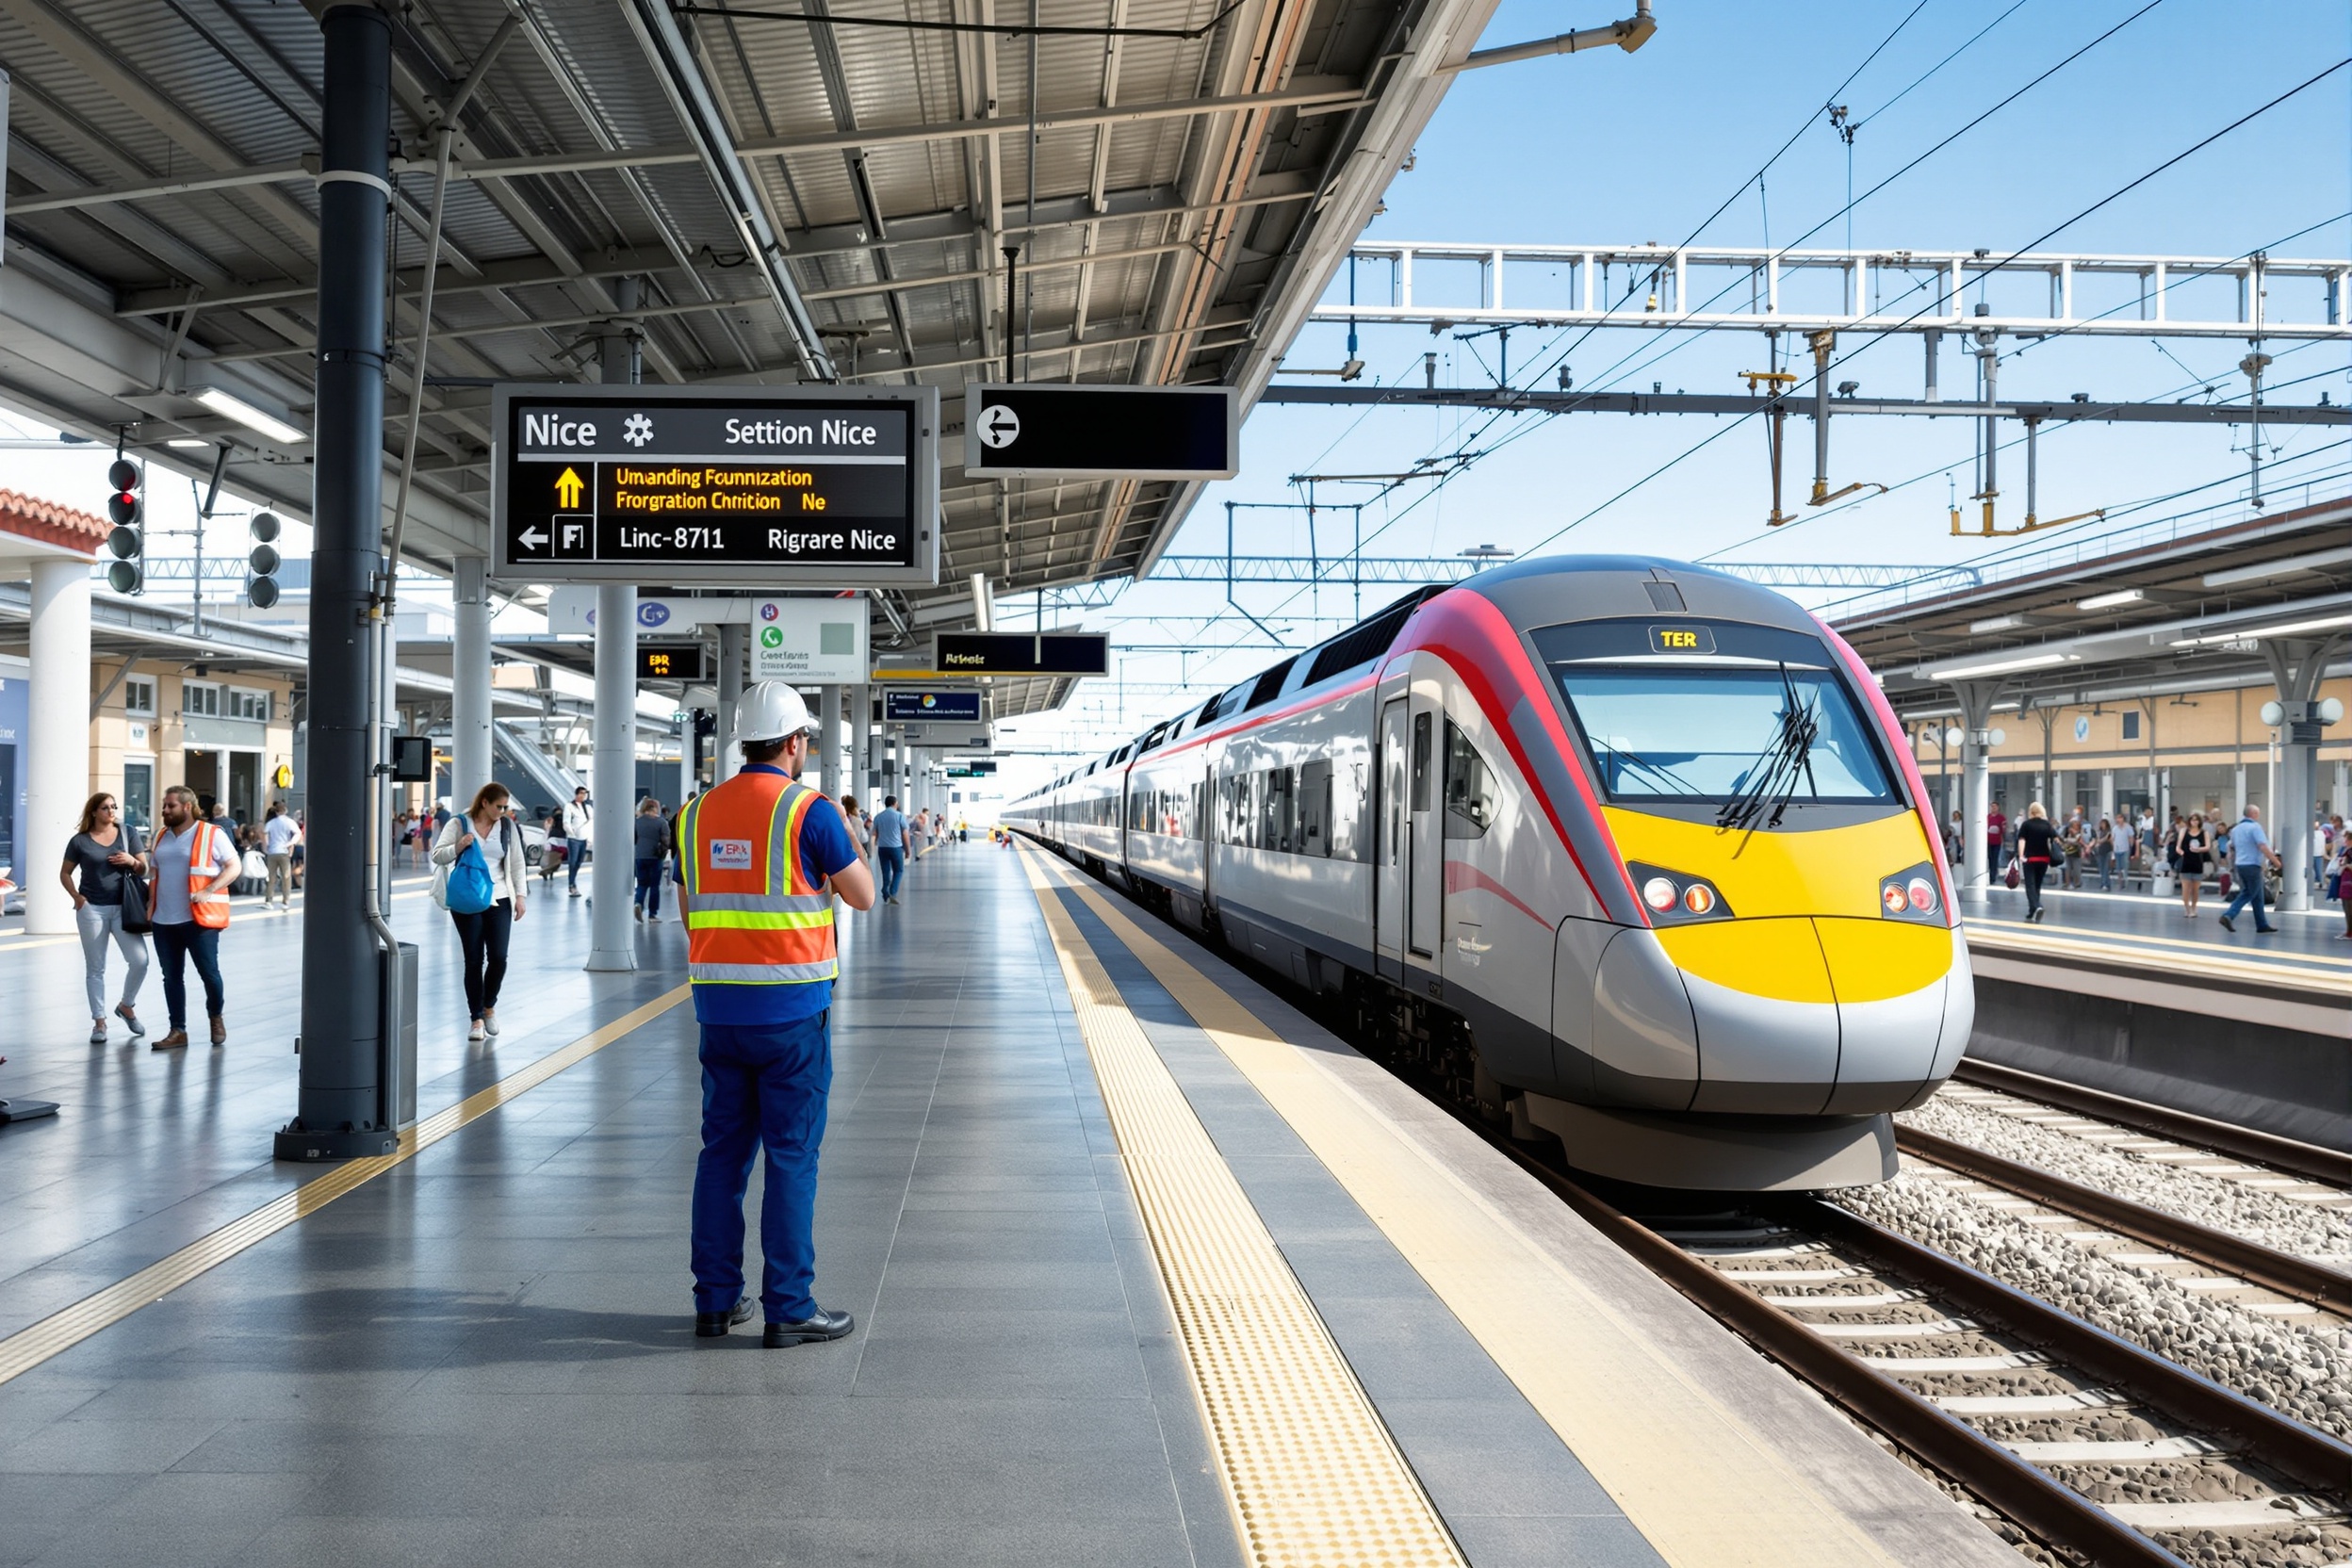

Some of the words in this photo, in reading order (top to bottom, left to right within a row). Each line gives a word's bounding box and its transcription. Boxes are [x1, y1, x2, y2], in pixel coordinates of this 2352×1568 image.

[525, 414, 597, 447] Nice
[725, 418, 813, 445] Settion
[822, 420, 877, 445] Nice
[802, 493, 826, 511] Ne
[768, 529, 844, 554] Rigrare
[851, 530, 896, 550] Nice
[1660, 630, 1697, 647] TER
